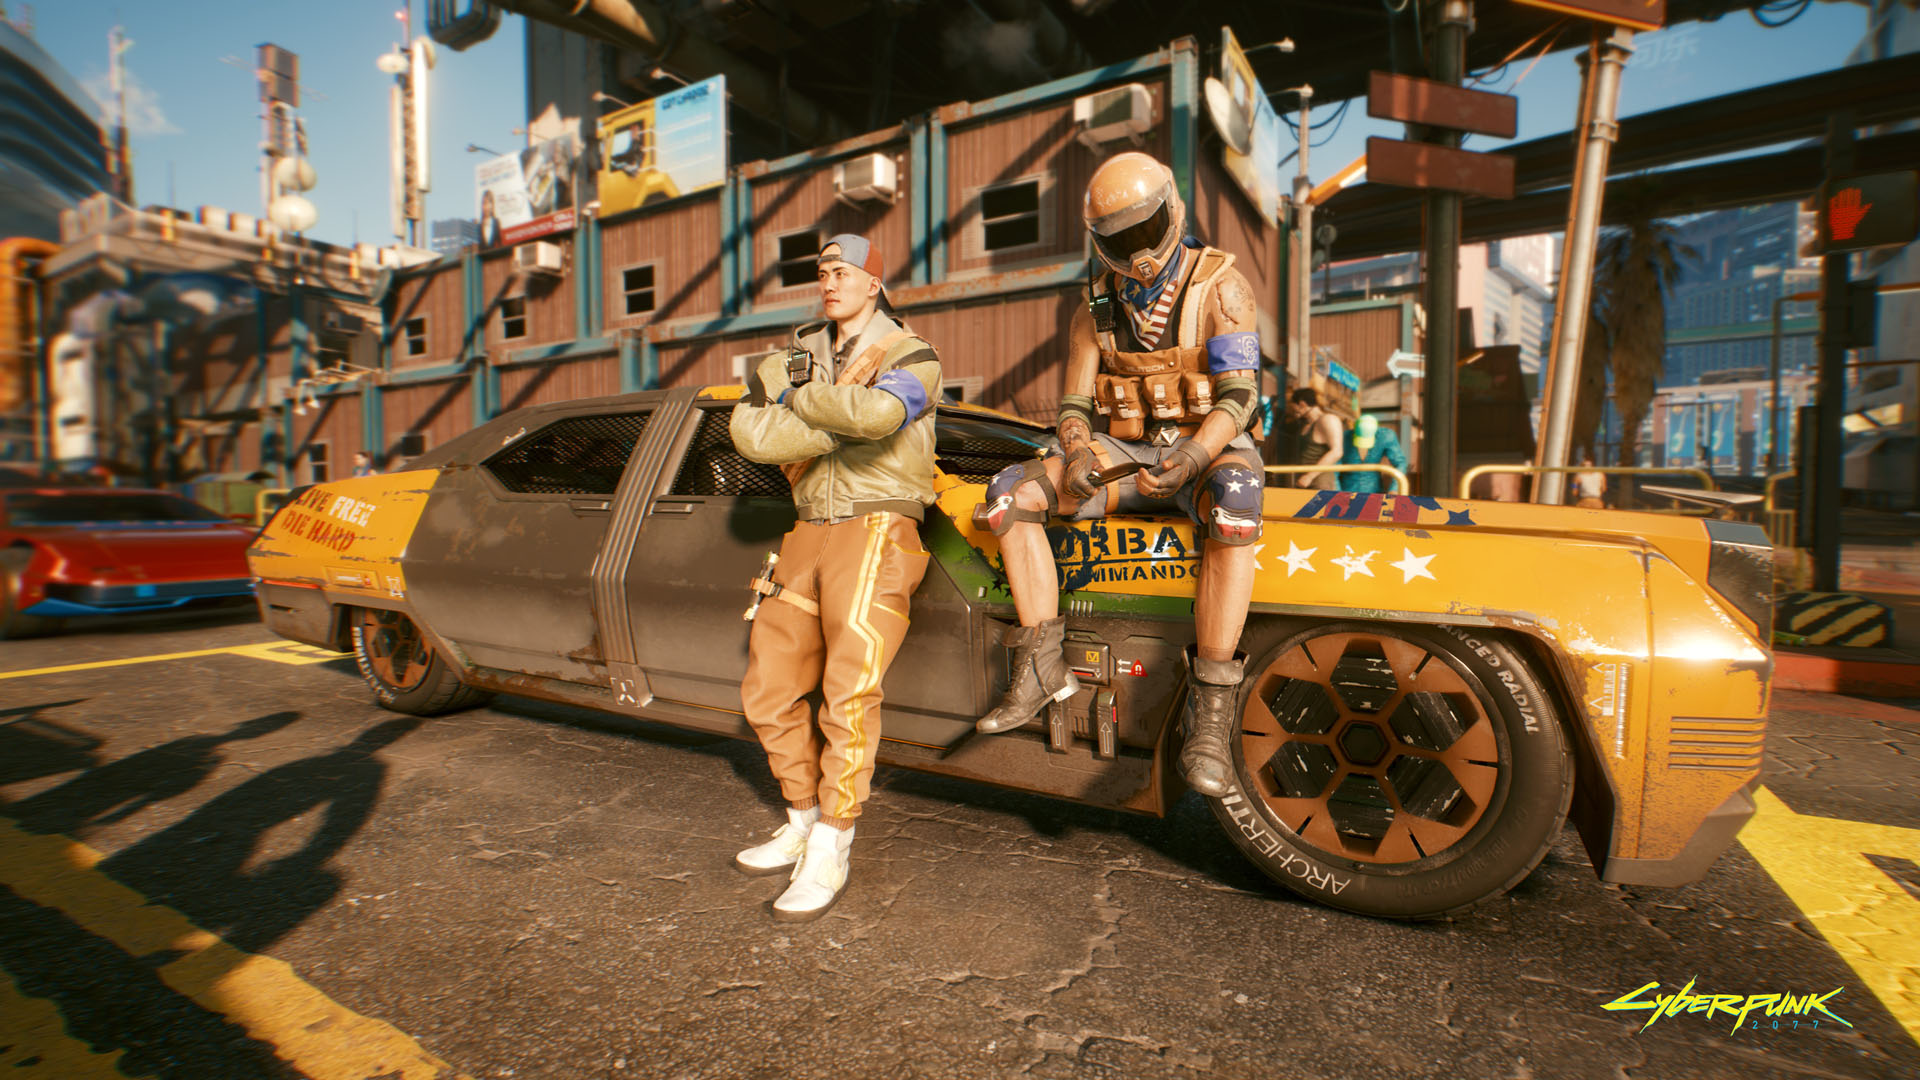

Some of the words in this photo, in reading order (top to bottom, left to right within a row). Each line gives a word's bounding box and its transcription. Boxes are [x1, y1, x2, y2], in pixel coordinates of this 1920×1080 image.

[281, 510, 311, 536] DIE
[306, 519, 355, 552] HARD
[1497, 670, 1539, 735] RADIAL
